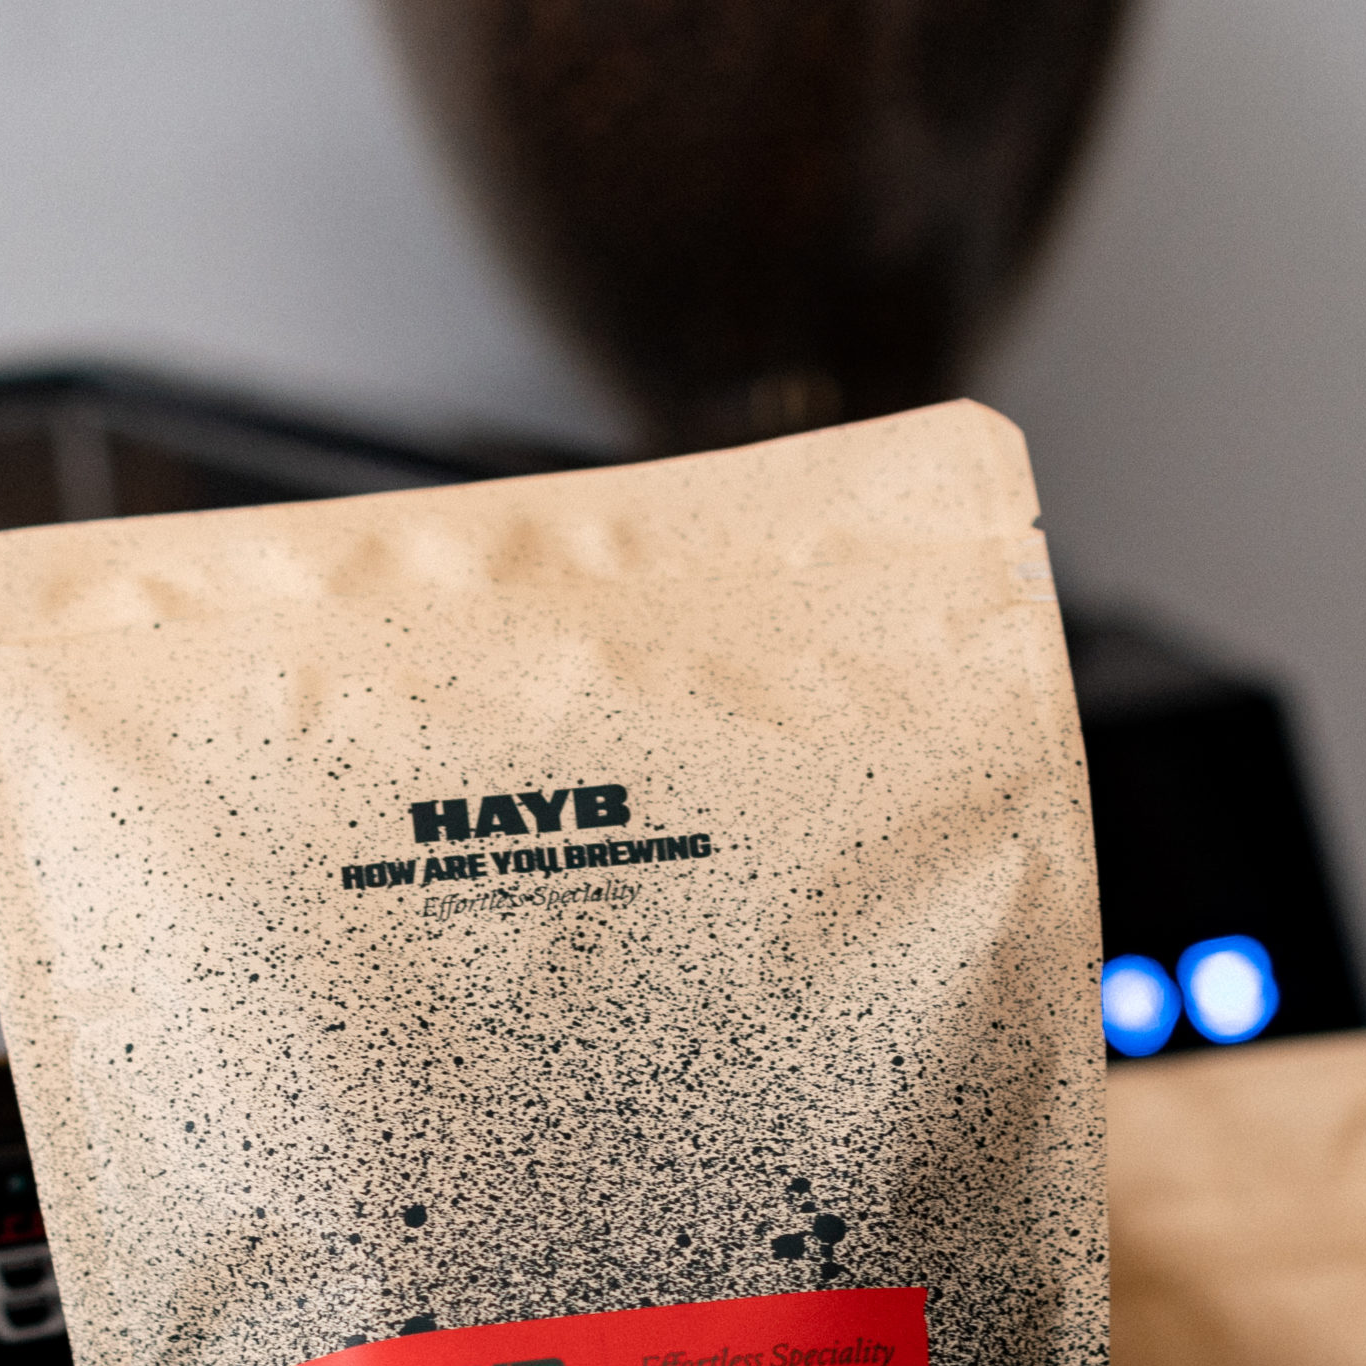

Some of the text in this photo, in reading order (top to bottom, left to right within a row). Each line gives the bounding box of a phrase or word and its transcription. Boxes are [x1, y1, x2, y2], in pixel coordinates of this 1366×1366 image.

[411, 784, 631, 843] HAYB
[342, 833, 712, 890] HOW ARE YOU BREWING
[423, 880, 643, 922] Effortless Speciality
